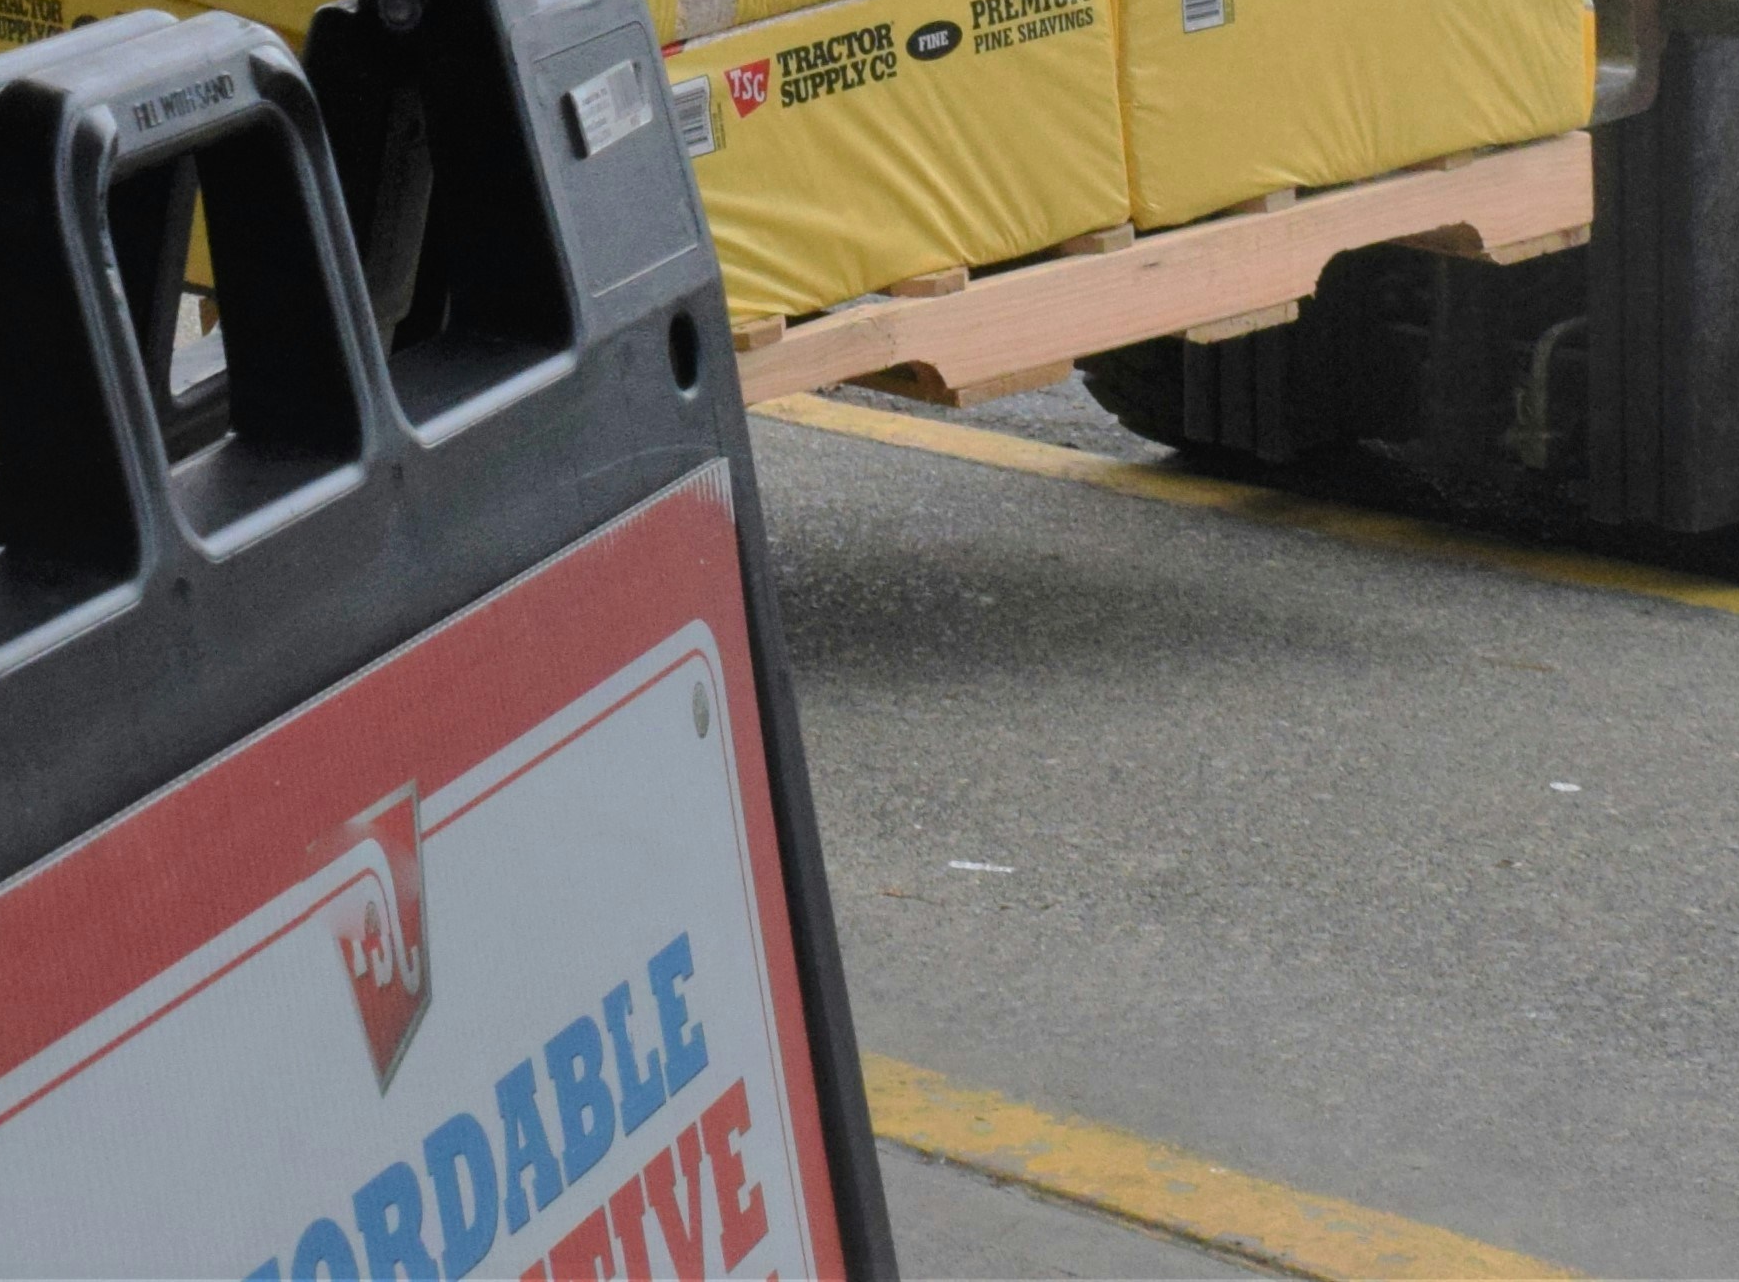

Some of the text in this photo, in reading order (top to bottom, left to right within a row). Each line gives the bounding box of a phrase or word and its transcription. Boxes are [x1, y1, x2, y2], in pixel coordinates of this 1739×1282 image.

[777, 23, 894, 78] TRACTOR
[918, 30, 949, 52] FINE
[975, 7, 1093, 54] PINE SHAVINGS
[729, 68, 766, 102] TSC
[781, 65, 866, 108] SUPPLY
[520, 1077, 769, 1282] TIVE
